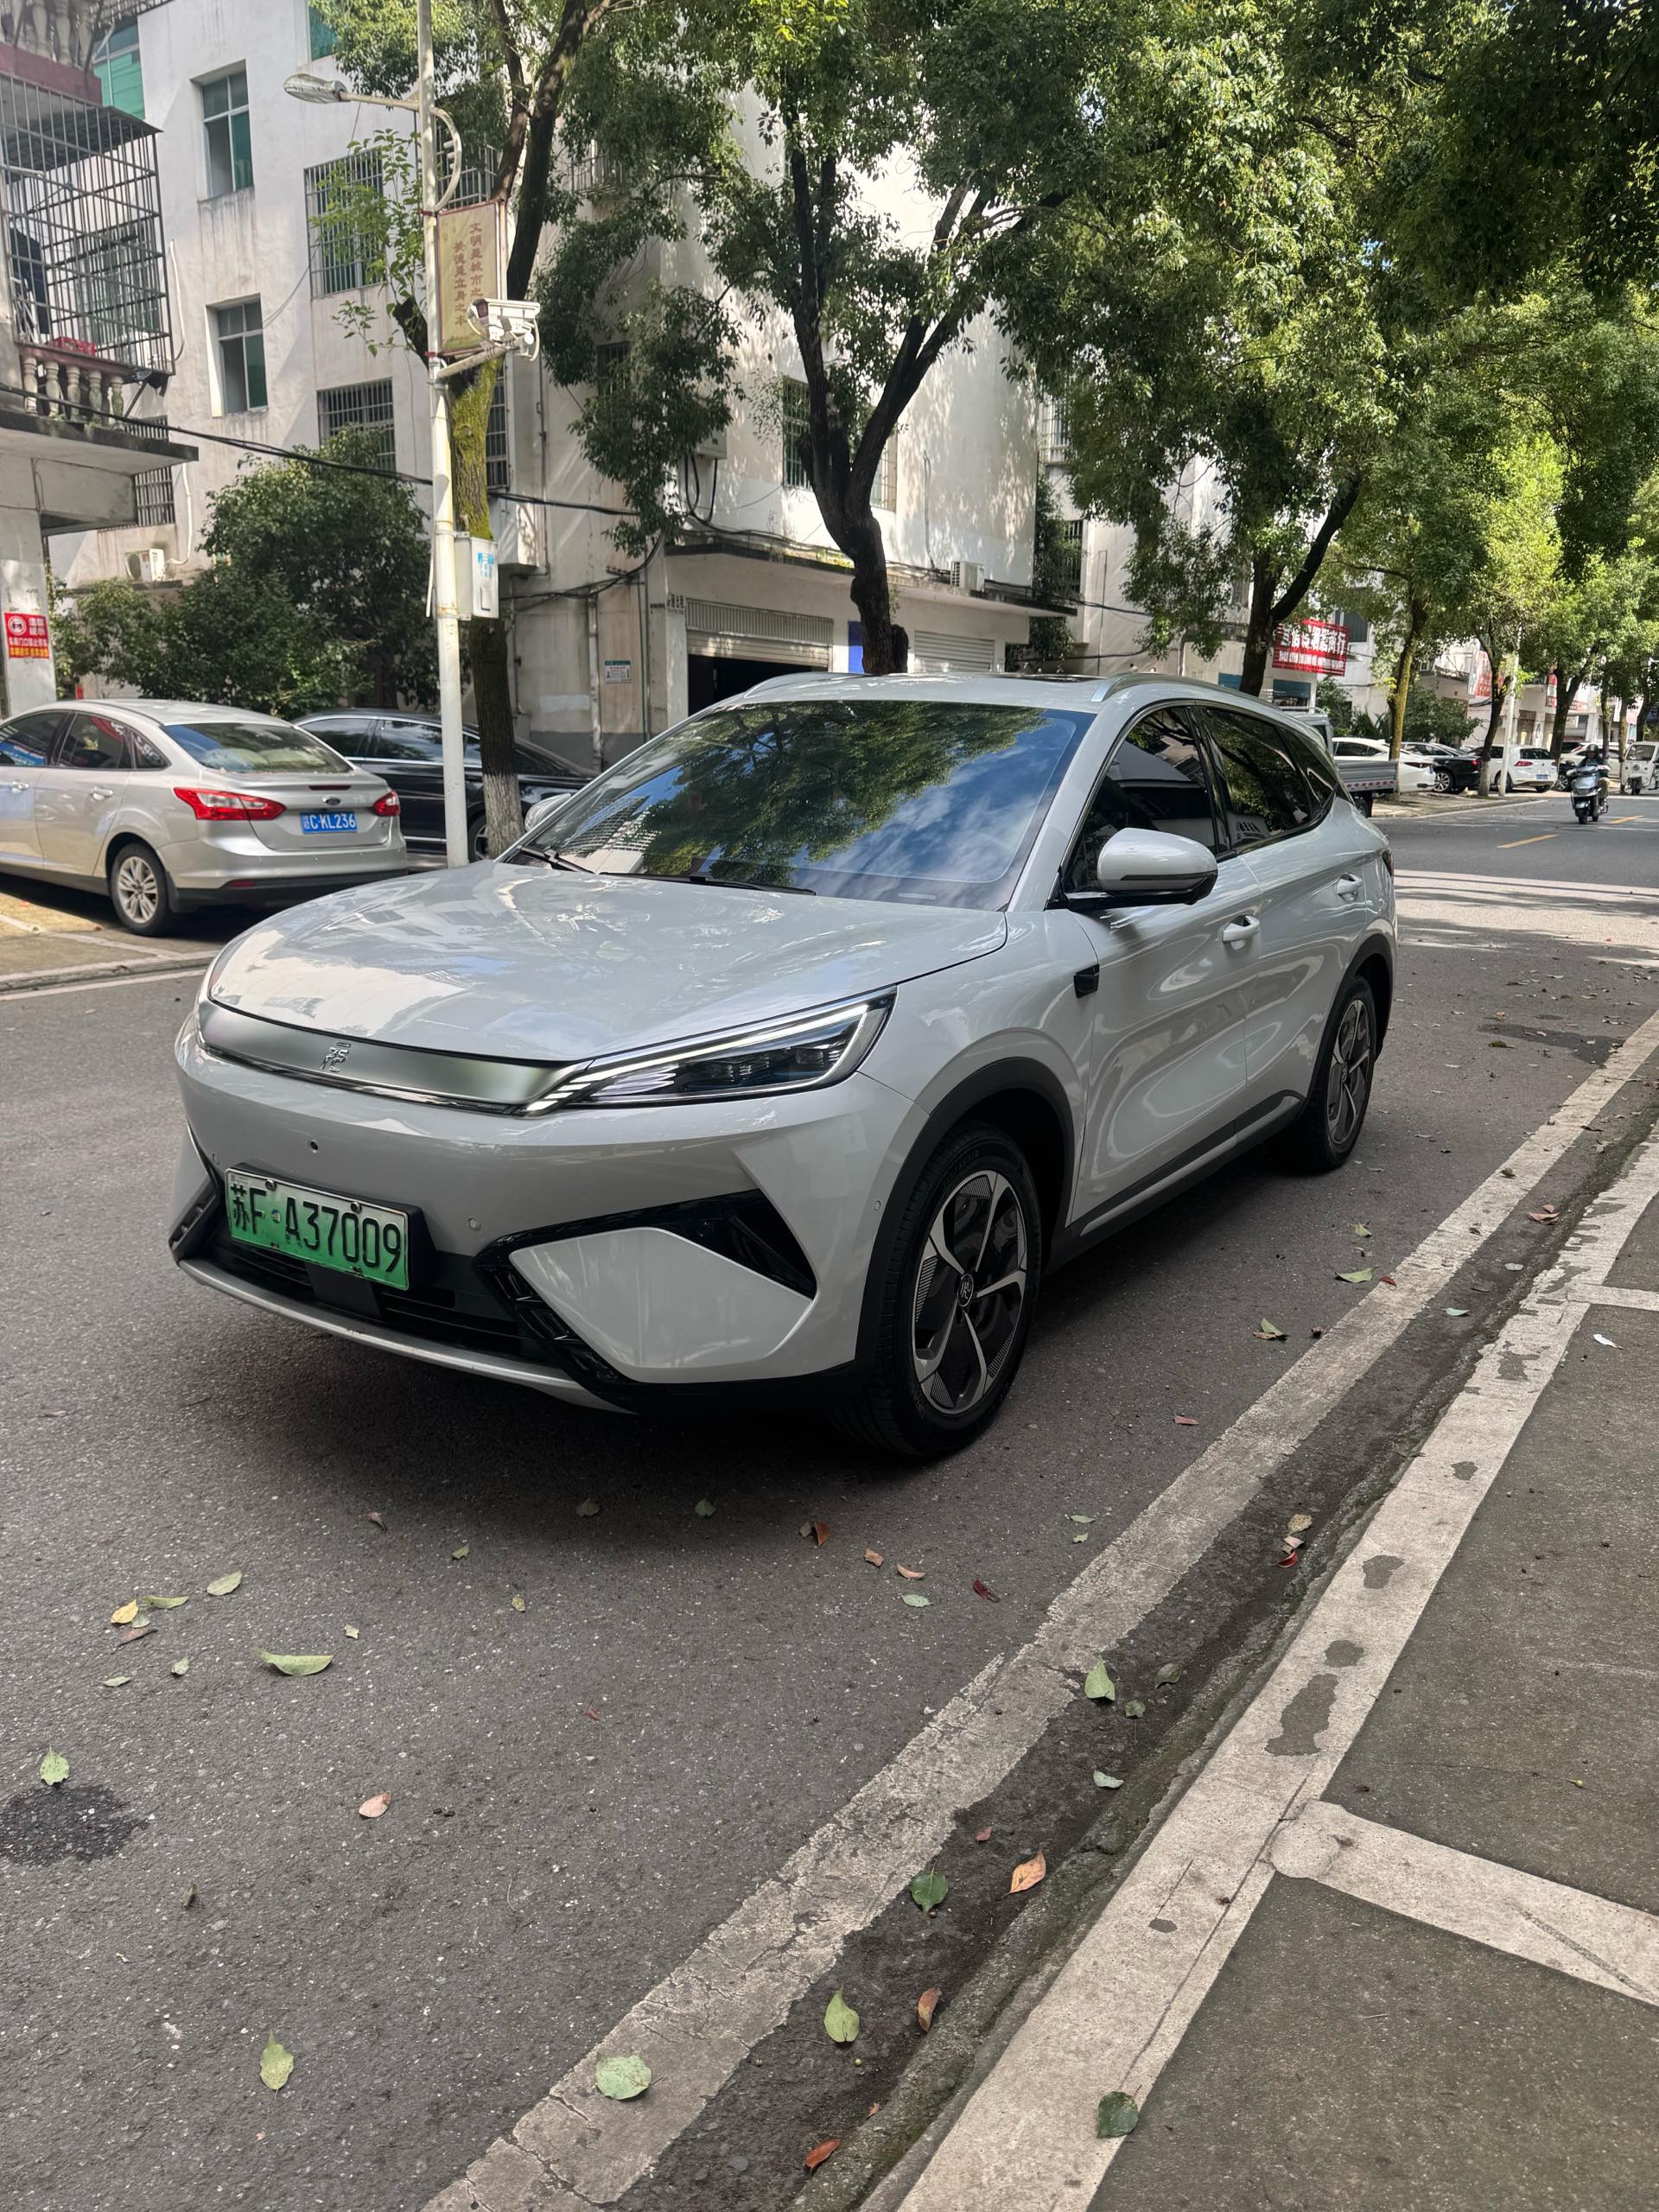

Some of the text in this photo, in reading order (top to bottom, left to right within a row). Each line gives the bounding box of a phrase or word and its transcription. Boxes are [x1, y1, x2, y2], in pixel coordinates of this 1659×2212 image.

[469, 222, 483, 297] 文明是城市之
